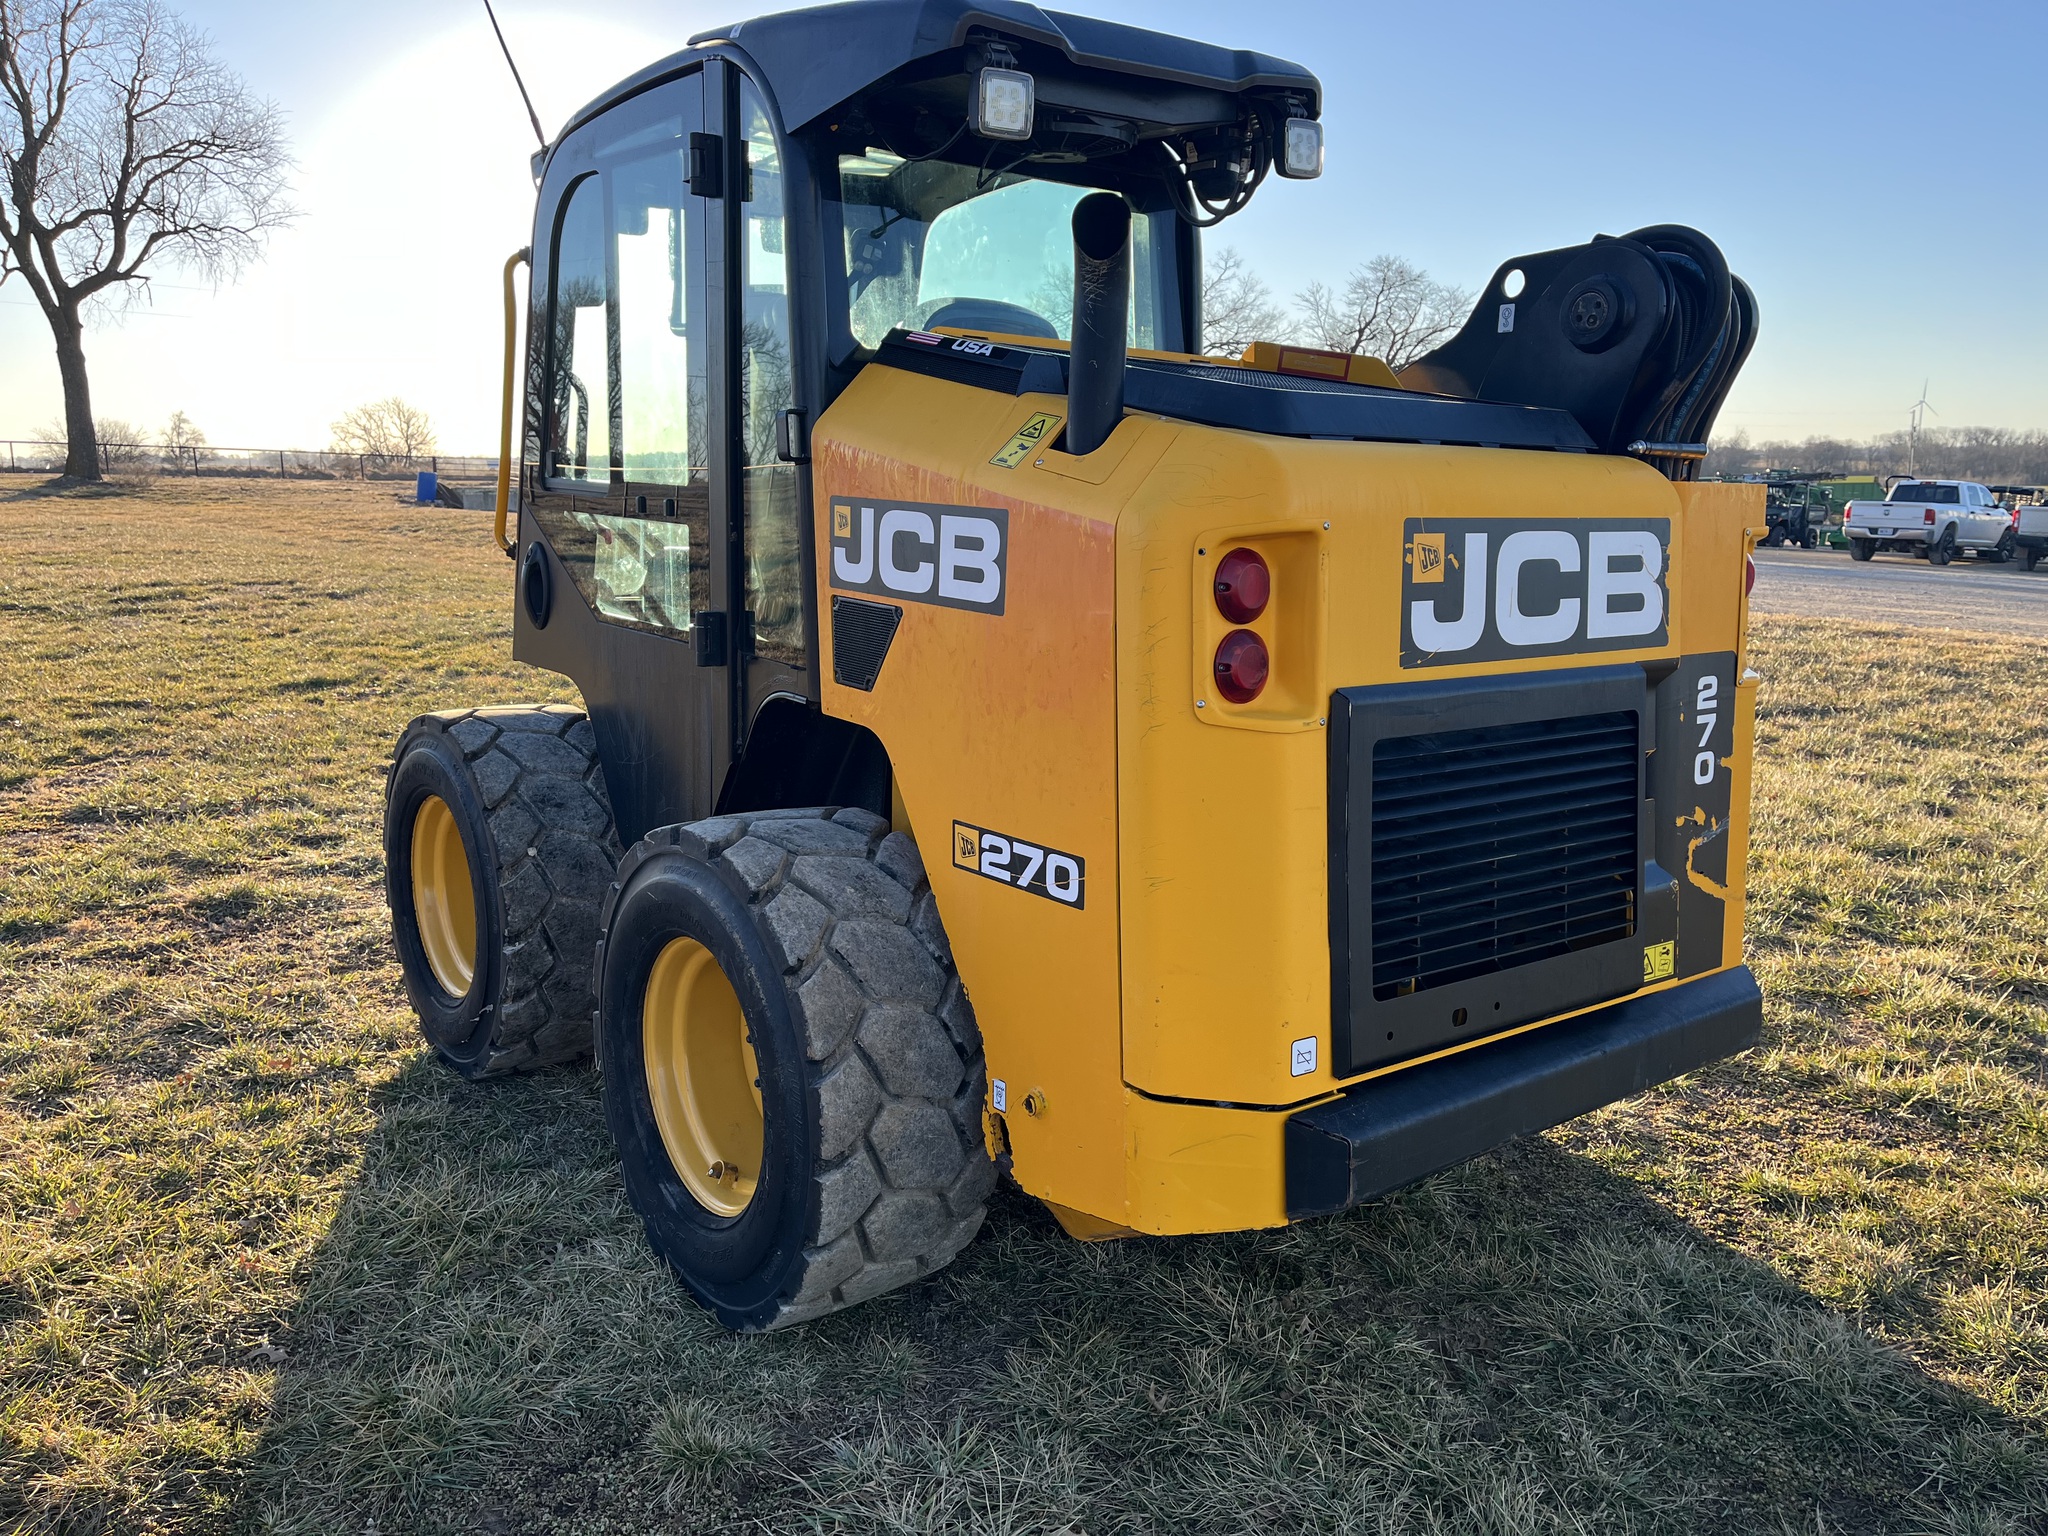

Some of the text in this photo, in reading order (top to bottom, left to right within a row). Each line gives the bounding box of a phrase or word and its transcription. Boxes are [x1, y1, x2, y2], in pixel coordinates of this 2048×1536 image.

[951, 339, 994, 357] USA
[834, 507, 1001, 604] JCB
[1410, 530, 1664, 653] JCB
[1421, 546, 1440, 571] JCB
[1693, 675, 1719, 785] 270
[960, 833, 1080, 903] JCB 270
